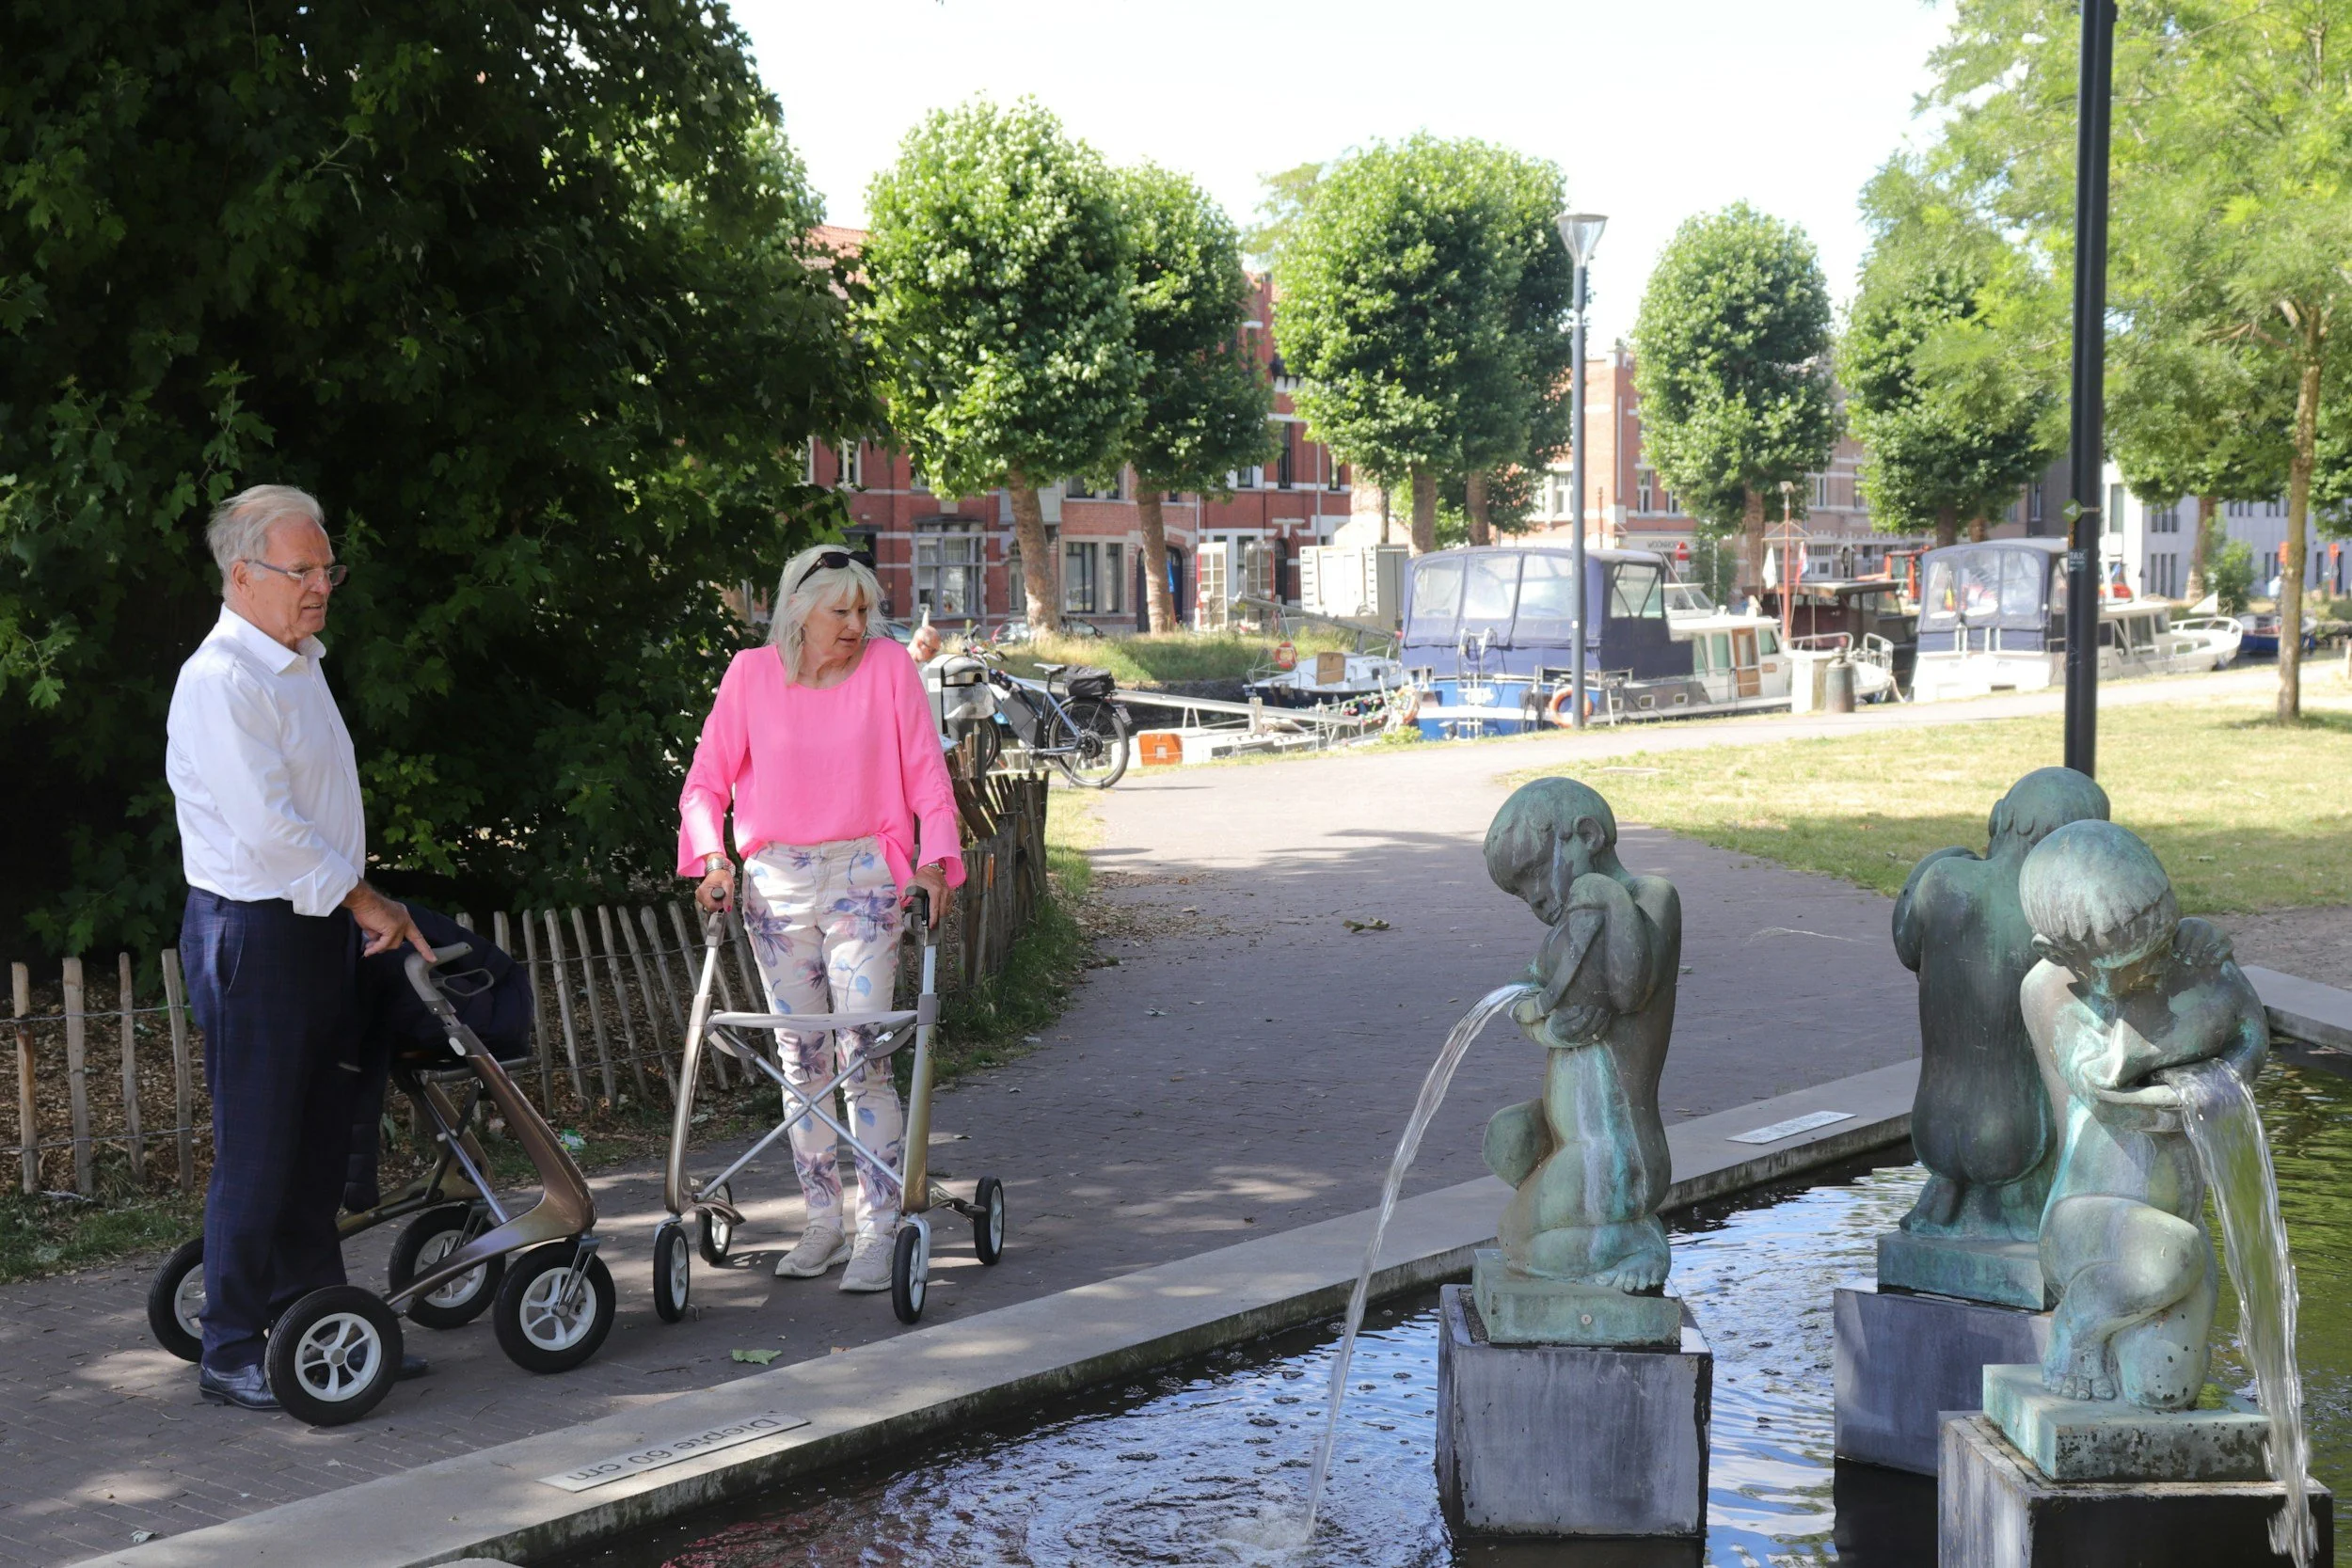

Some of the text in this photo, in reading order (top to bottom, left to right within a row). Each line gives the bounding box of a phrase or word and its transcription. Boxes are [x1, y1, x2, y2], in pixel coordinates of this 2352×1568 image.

[566, 1418, 782, 1481] Diepte 60 cm
